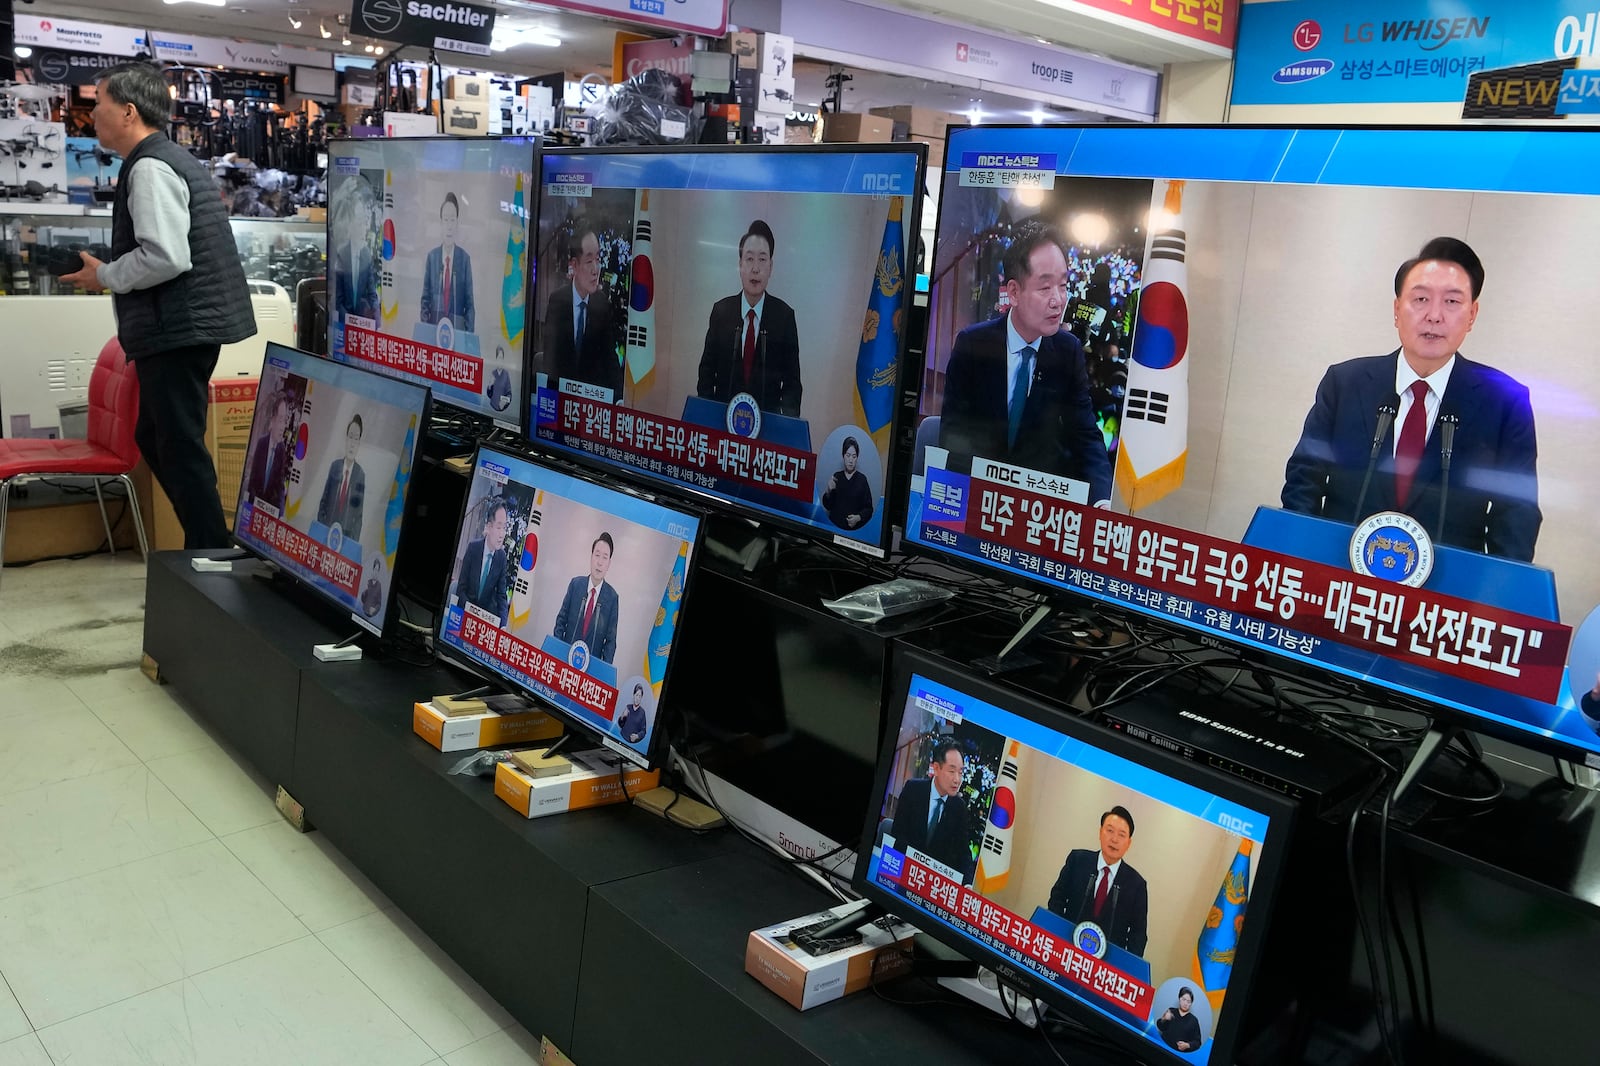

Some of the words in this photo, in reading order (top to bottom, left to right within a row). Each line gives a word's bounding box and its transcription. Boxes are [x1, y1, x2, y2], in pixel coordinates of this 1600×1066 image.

[407, 0, 489, 27] sachtler
[56, 27, 102, 39] Manfrotto
[1344, 23, 1374, 43] LG
[1382, 16, 1490, 51] WHISEN
[1032, 61, 1059, 81] troop
[1280, 66, 1326, 76] SAMSUNG
[222, 77, 277, 91] GoPro
[1477, 80, 1559, 106] NEW
[978, 155, 1003, 166] MBC
[1005, 156, 1039, 167] 뉴스특보
[862, 173, 901, 191] MBC
[969, 171, 995, 183] 한동훈
[998, 172, 1020, 185] "탄핵
[566, 382, 582, 394] MBC
[540, 396, 556, 414] 특보
[564, 400, 580, 430] 민주
[582, 403, 613, 443] "윤석열,
[616, 413, 635, 446] 탄핵
[636, 417, 663, 452] 앞두고
[665, 425, 685, 459] 극우
[753, 447, 806, 489] 선전포고"
[594, 443, 606, 456] 투입
[680, 470, 694, 483] 사태
[986, 464, 1020, 485] MBC
[1026, 474, 1070, 496] 뉴스속보
[929, 480, 963, 509] 특보
[928, 503, 941, 513] MBC
[942, 506, 960, 518] NEWS
[668, 522, 689, 539] MBC
[925, 529, 957, 546] 뉴스특보
[980, 490, 1014, 537] 민주
[1020, 499, 1085, 563] "윤석열,
[1093, 518, 1131, 571] 탄핵
[1136, 529, 1199, 586] 앞두고
[1204, 548, 1248, 602] 극우
[1409, 600, 1543, 678] 선전포고"
[980, 541, 1011, 563] 박선원
[1014, 550, 1040, 572] "국회
[1043, 560, 1067, 579] 투입
[1069, 567, 1105, 592] 계엄군
[1235, 616, 1265, 641] 사태
[1269, 626, 1321, 655] 가능성"
[464, 617, 477, 640] 민주
[478, 622, 497, 655] "윤석열,
[497, 634, 511, 659] 탄핵
[509, 641, 529, 668] 앞두고
[528, 651, 542, 676] 극우
[579, 678, 613, 711] 선전포고"
[925, 694, 939, 704] MBC
[1150, 735, 1180, 753] Splitter
[1179, 710, 1211, 724] HDMI
[1210, 721, 1255, 740] Splitter
[1285, 748, 1305, 758] out
[600, 782, 616, 792] WALL
[1219, 812, 1254, 836] MBC
[779, 831, 804, 857] 5mm
[883, 852, 900, 871] 특보
[913, 852, 930, 866] MBC
[933, 861, 954, 879] 뉴스속보
[907, 864, 927, 891] 민주
[929, 873, 959, 913] "윤석열,
[961, 893, 982, 923] 탄핵
[980, 903, 1011, 937] 앞두고
[1012, 920, 1031, 949] 극우
[1094, 965, 1145, 1008] 선전포고"
[937, 907, 949, 920] 투입
[1022, 957, 1037, 970] 사태
